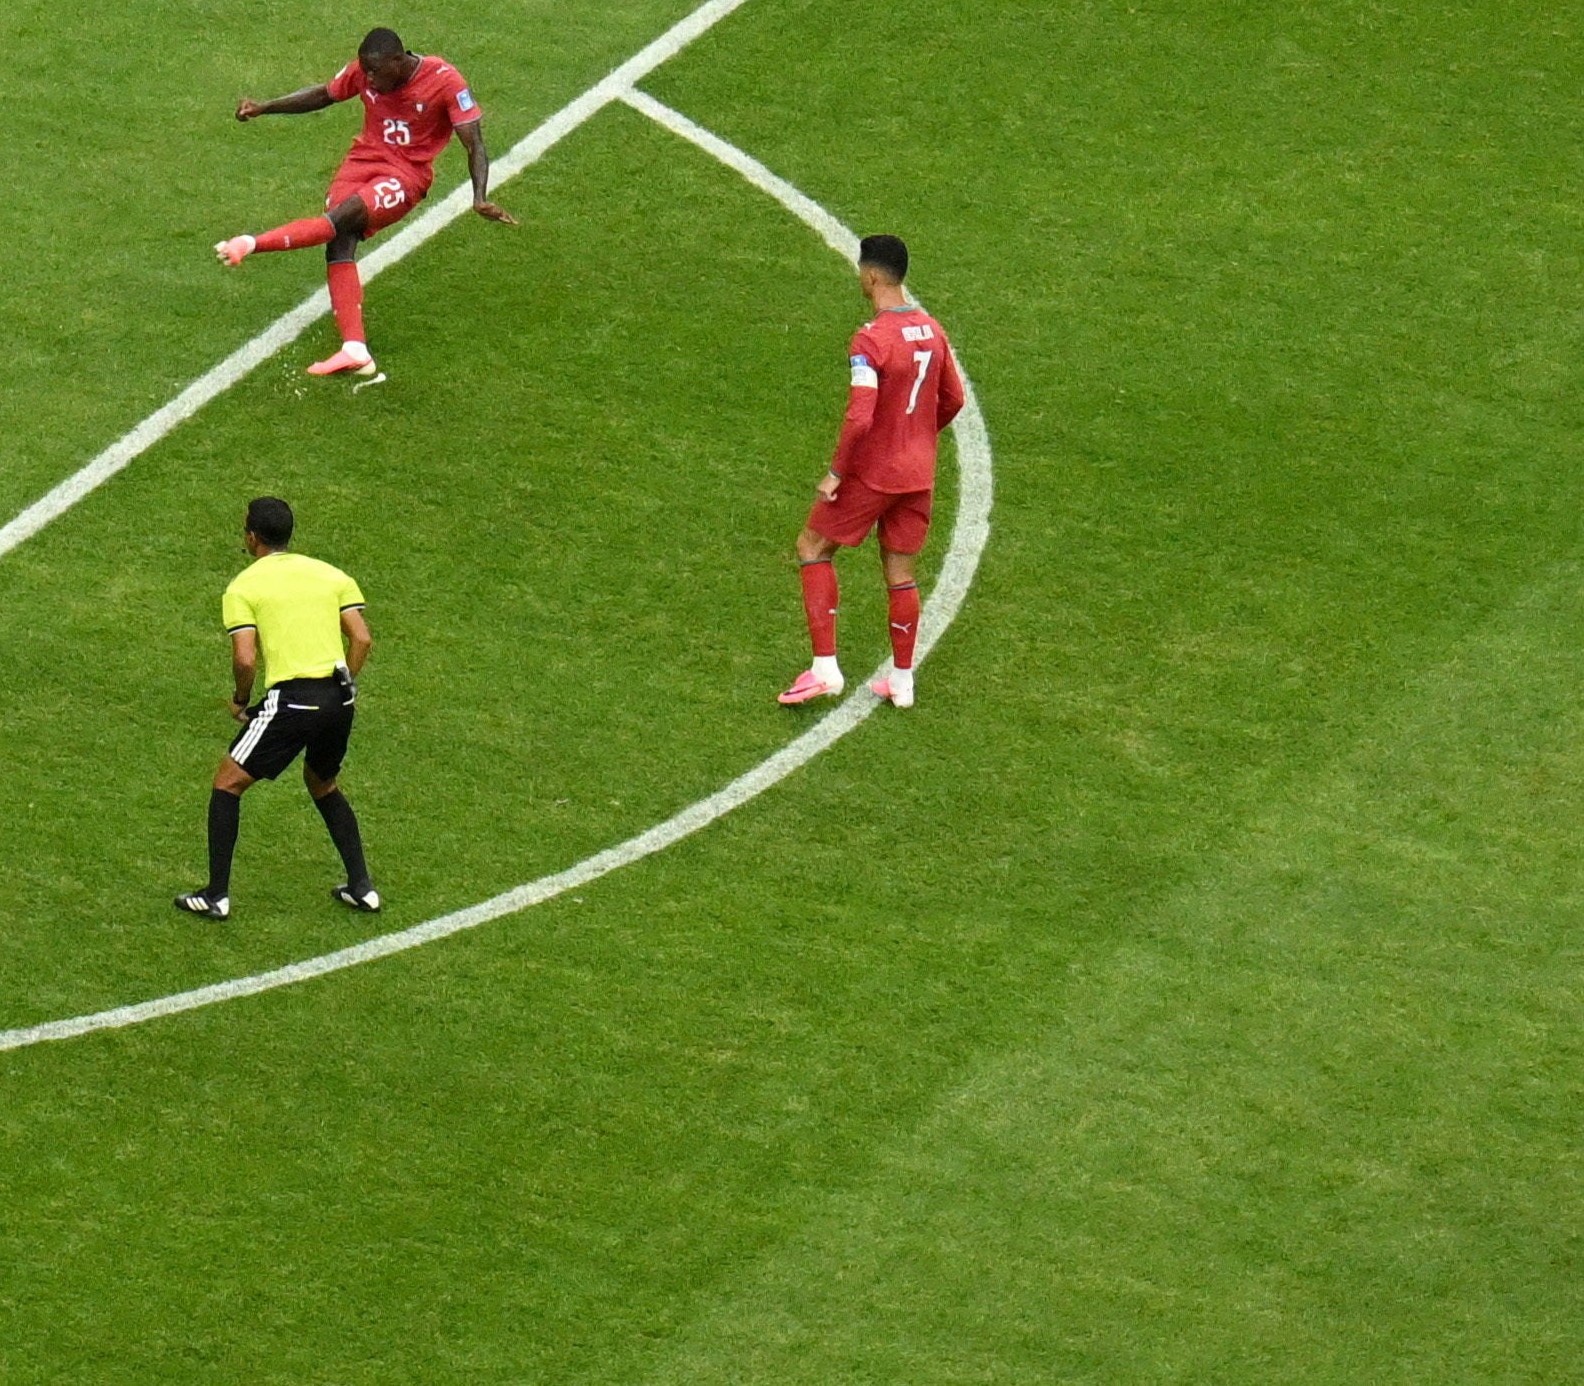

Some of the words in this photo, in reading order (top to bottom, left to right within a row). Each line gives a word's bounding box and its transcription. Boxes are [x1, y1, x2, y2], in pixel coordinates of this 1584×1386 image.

[382, 118, 410, 146] 25
[374, 177, 404, 209] 25
[905, 349, 932, 415] 7
